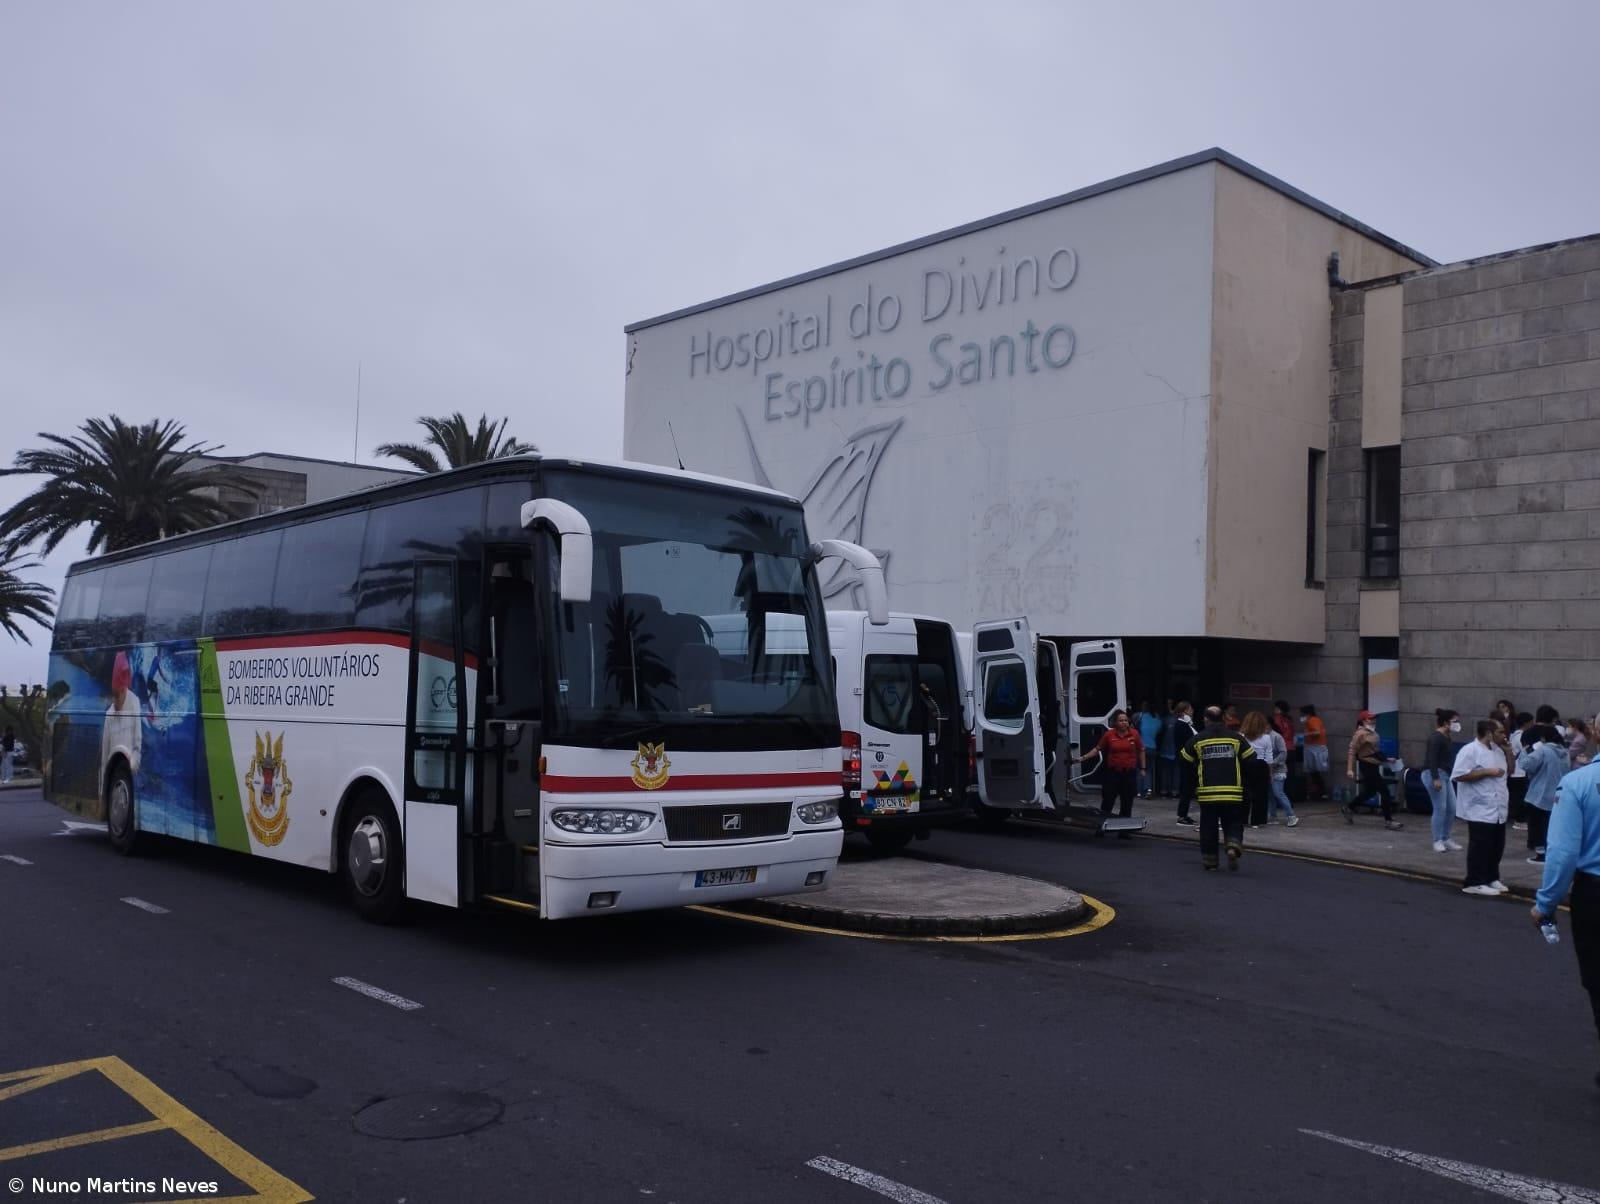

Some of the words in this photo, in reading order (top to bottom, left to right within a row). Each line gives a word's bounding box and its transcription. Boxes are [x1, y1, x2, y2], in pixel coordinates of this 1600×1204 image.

[690, 292, 832, 379] Hospital
[848, 281, 902, 341] do
[920, 246, 1080, 324] Divino
[764, 350, 911, 428] Espírito
[928, 318, 1076, 393] Santo
[226, 686, 242, 705] DA
[244, 685, 281, 705] RIBEIRA
[285, 685, 335, 706] GRANDE
[228, 658, 289, 679] BOMBEIROS
[292, 653, 379, 678] VOLUNTÁRIOS
